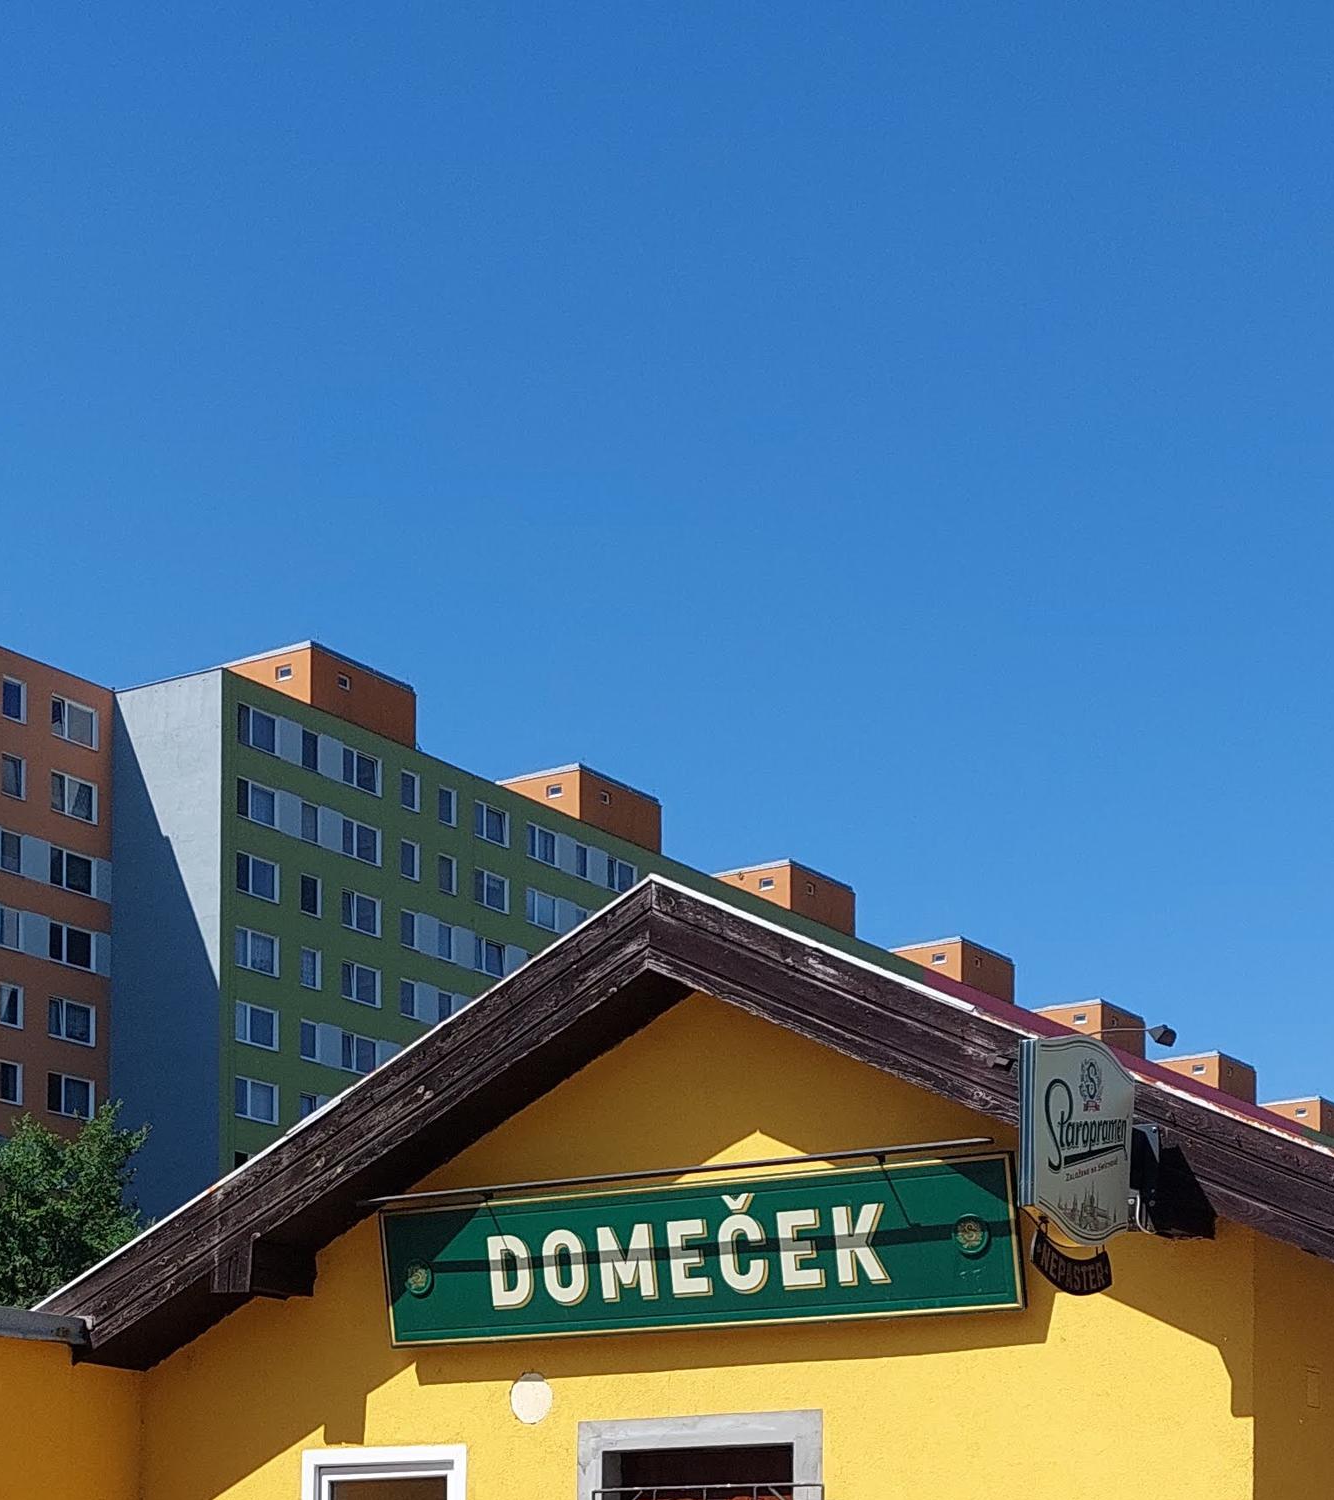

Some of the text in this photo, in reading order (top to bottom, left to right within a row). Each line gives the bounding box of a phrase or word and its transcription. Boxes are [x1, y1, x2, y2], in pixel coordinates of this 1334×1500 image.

[1044, 1078, 1128, 1171] Staropramen
[485, 1193, 892, 1310] DOMEČEK
[1040, 1242, 1106, 1290] NEPASTER
